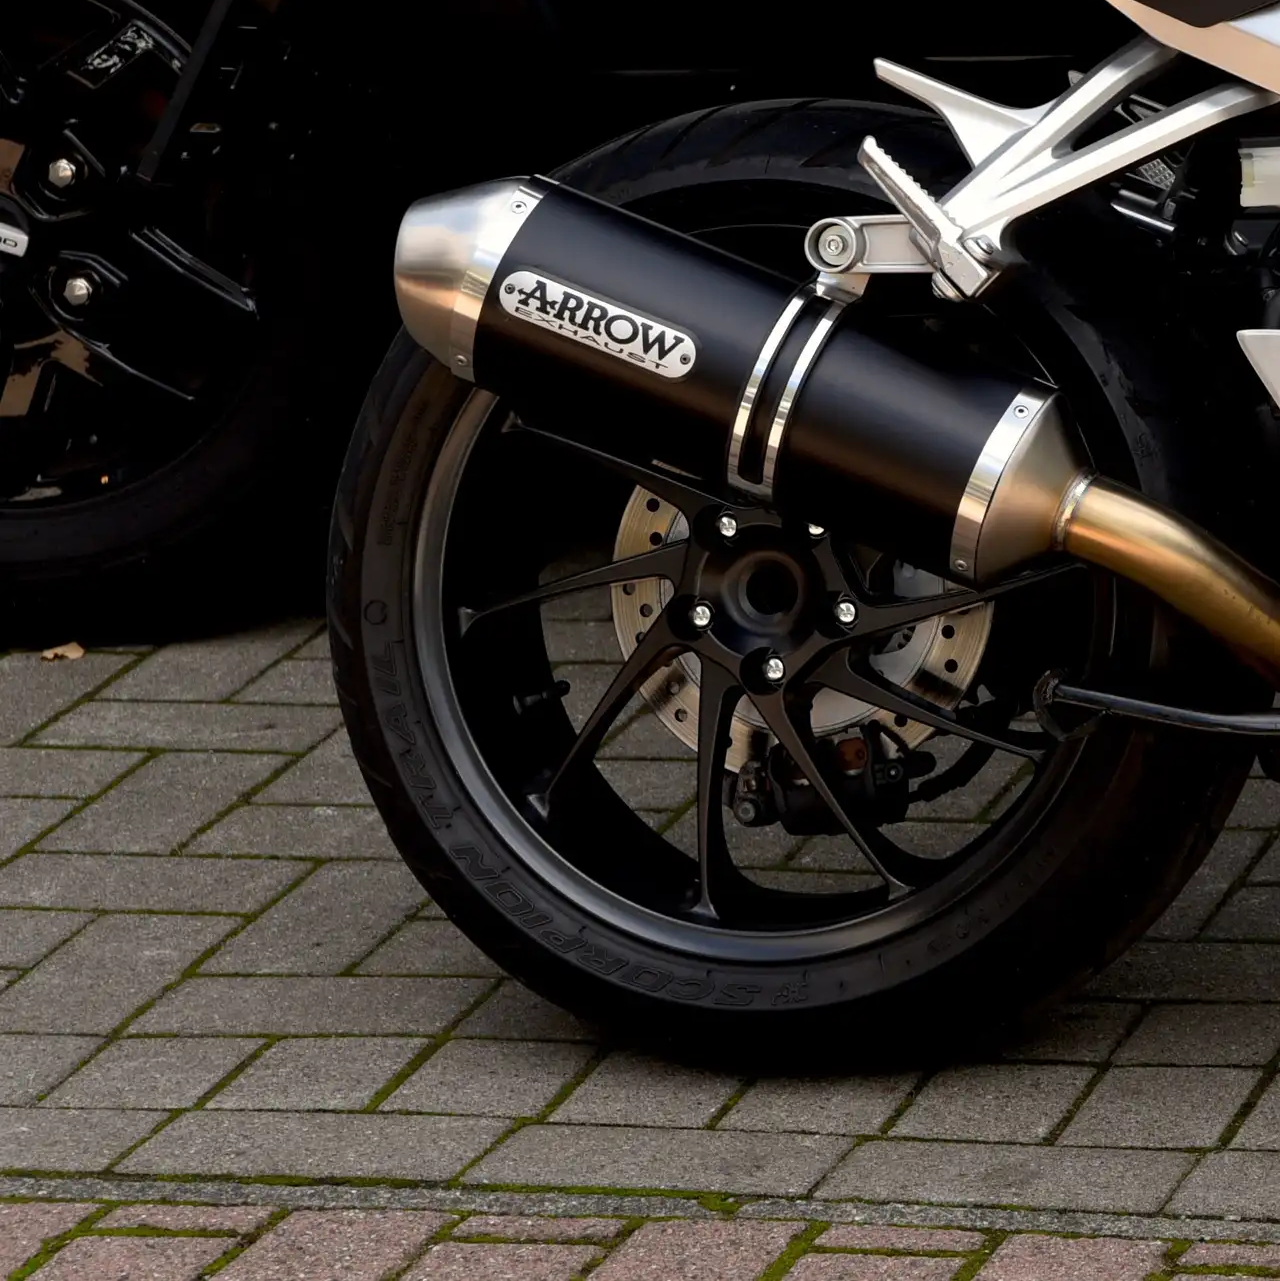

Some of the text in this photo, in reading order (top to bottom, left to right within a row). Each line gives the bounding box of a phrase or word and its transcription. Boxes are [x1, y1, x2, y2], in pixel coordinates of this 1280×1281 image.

[514, 306, 669, 370] EXHAUST
[516, 279, 685, 361] ARROW
[372, 639, 453, 829] TRAIL
[449, 845, 762, 1008] SCORPION
